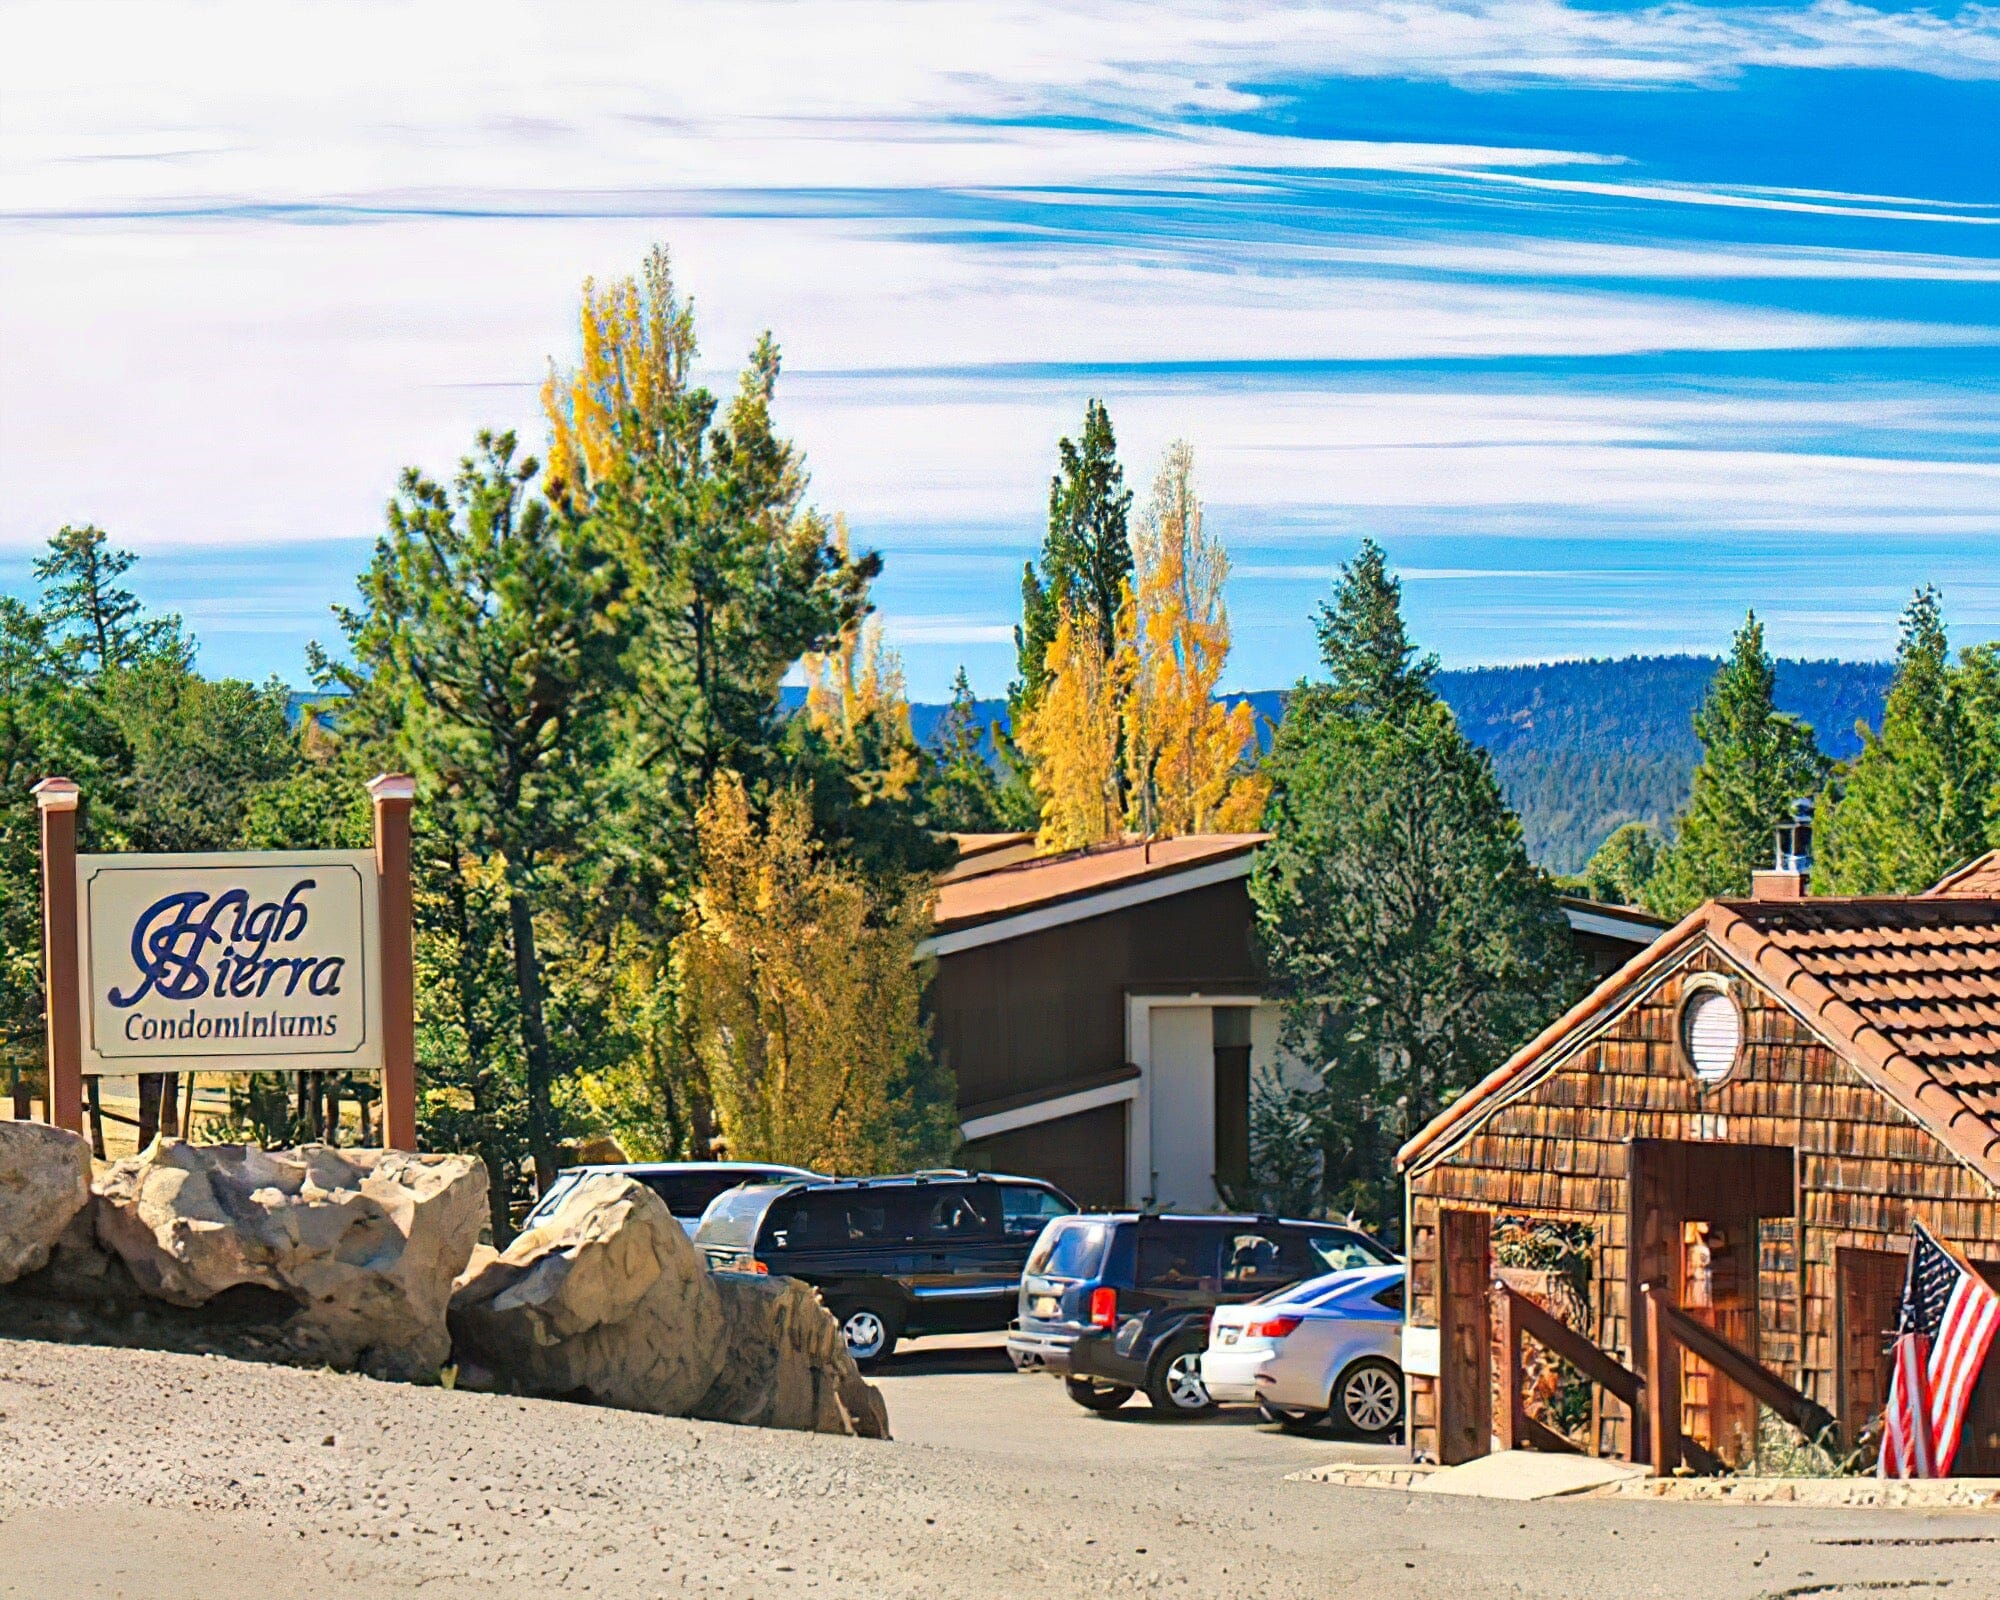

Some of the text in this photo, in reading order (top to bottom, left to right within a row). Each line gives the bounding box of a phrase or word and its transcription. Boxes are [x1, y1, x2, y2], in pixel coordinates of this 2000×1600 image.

[130, 879, 316, 957] High
[108, 933, 346, 1007] Sierra
[125, 1009, 338, 1041] Condominiums
